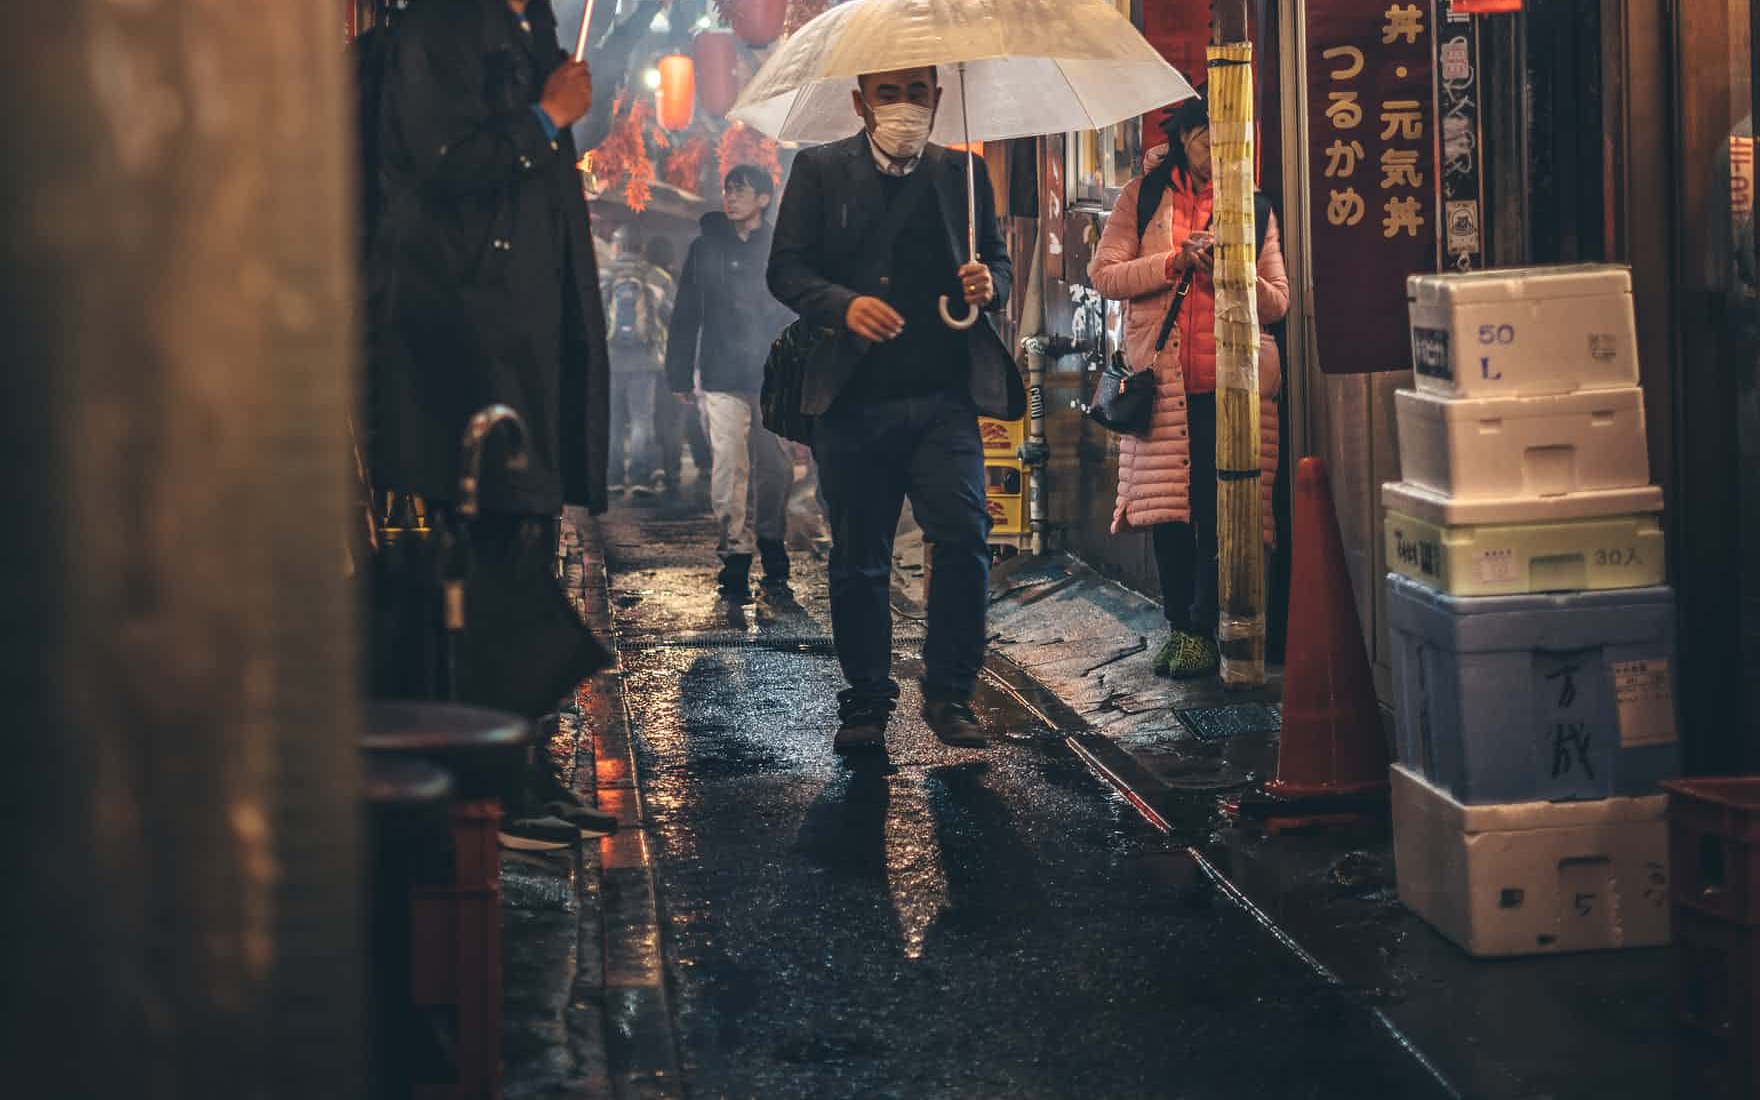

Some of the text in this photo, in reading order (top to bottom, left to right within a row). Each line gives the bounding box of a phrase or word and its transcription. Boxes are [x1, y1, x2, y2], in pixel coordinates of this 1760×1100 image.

[1322, 45, 1366, 228] つるかめ
[1478, 324, 1516, 345] 50
